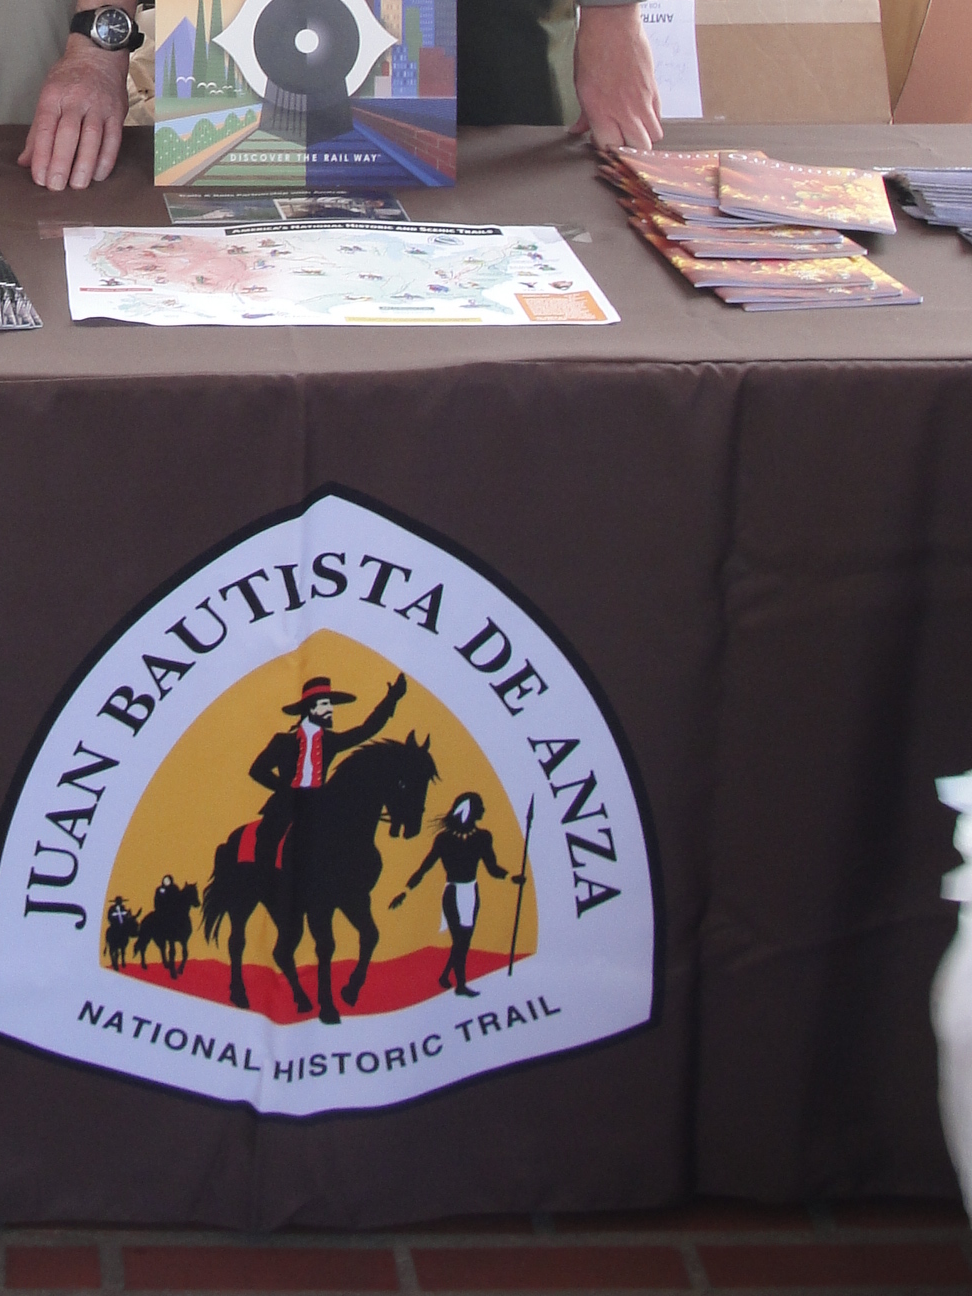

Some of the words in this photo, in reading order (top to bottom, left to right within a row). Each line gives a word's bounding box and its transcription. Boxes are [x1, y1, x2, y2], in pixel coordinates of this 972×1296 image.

[640, 13, 674, 24] AMTR
[229, 152, 301, 163] DISCOVER
[303, 152, 322, 163] THE
[323, 153, 350, 163] RAIL
[419, 226, 455, 234] SCENIC
[24, 741, 120, 930] JUAN
[96, 551, 446, 737] BAUTISTA
[453, 616, 549, 717] DE
[526, 734, 622, 920] ANZA
[76, 999, 262, 1073] NATIONAL
[273, 1032, 445, 1084] HISTORIC
[453, 994, 562, 1043] TRAIL
